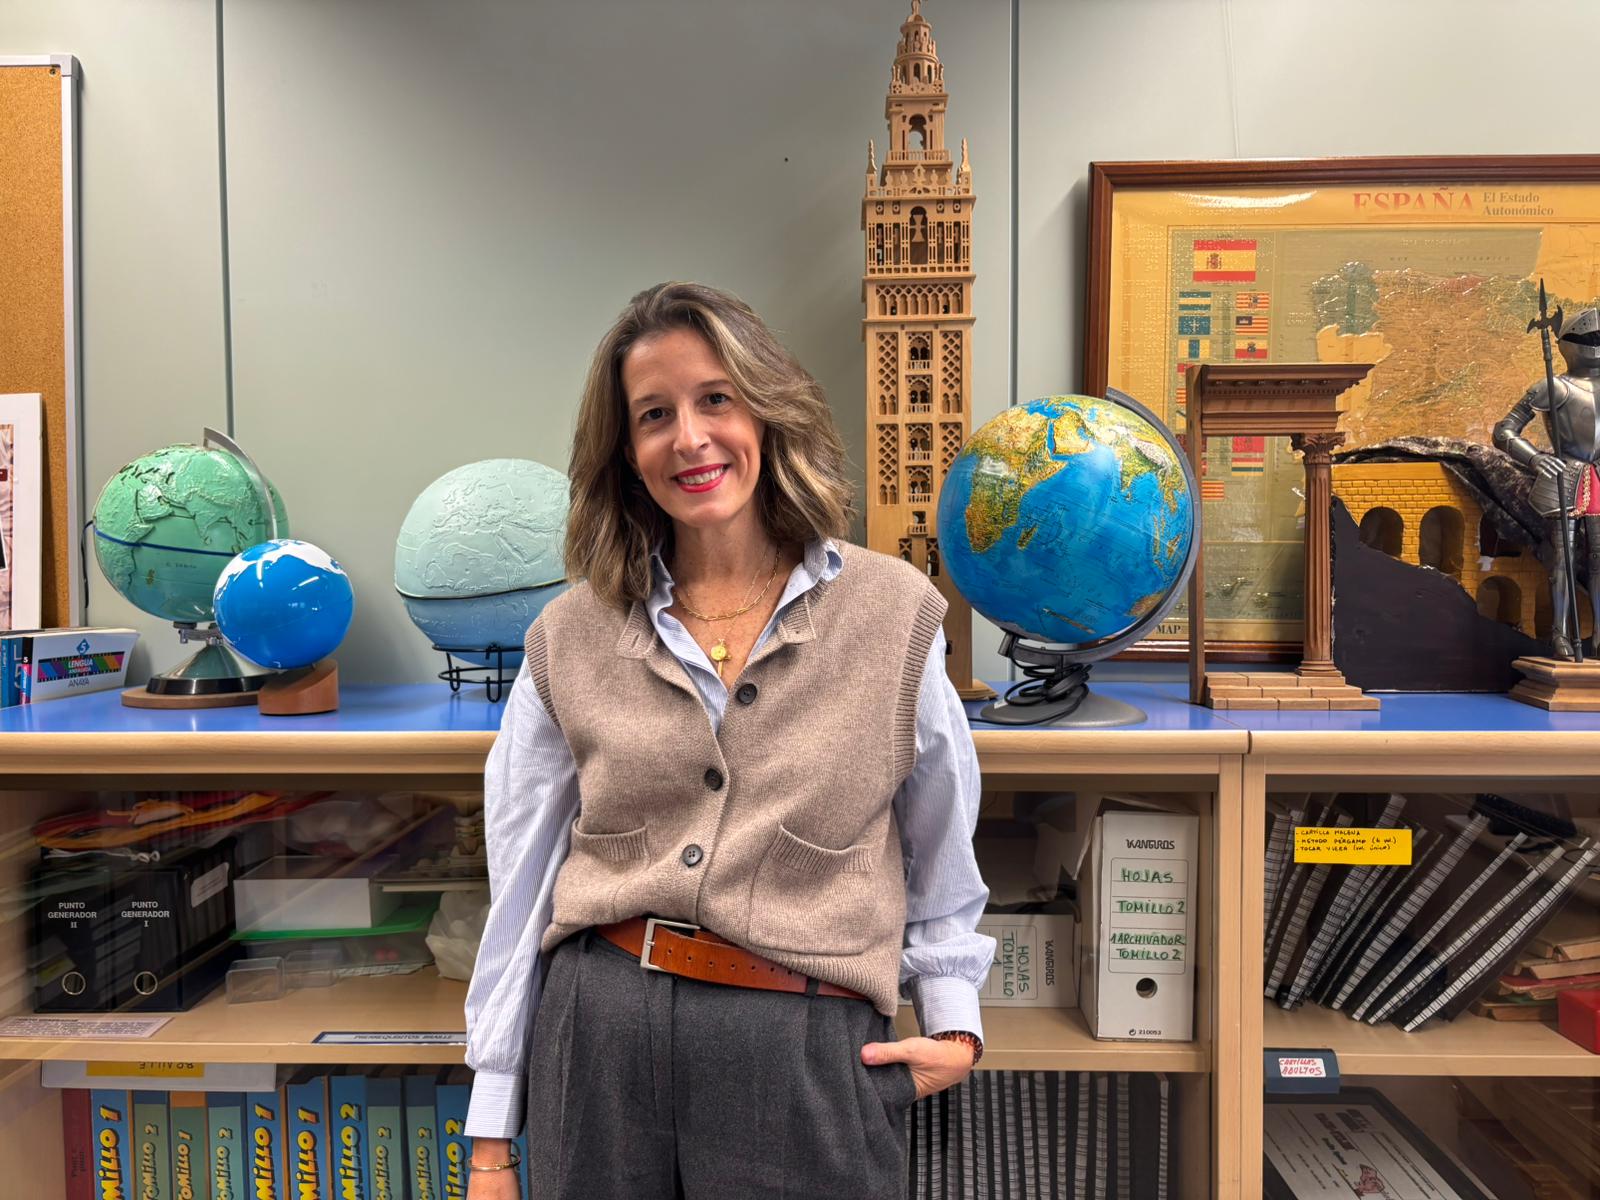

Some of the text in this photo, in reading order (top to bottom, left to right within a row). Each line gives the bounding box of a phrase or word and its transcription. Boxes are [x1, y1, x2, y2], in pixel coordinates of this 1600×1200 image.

[1353, 186, 1473, 210] ESPAÑA
[1483, 192, 1540, 203] El Estado
[1483, 205, 1554, 216] Autonómico
[67, 679, 90, 688] ANAYA
[1121, 868, 1174, 883] HOJAS
[131, 901, 159, 909] PUNTO
[1177, 901, 1185, 914] 2
[47, 911, 97, 919] GENERADOR
[121, 910, 170, 918] GENERADOR
[70, 921, 78, 929] II
[143, 920, 149, 928] I
[1117, 932, 1187, 945] ARCHIVADOR
[1172, 949, 1182, 960] 2
[1002, 931, 1015, 997] TOMILLO
[1017, 945, 1030, 993] HOJAS
[100, 1104, 122, 1121] 1
[254, 1104, 275, 1121] 1
[298, 1107, 320, 1124] 1
[340, 1103, 362, 1121] 2
[144, 1123, 159, 1136] 2
[218, 1127, 233, 1139] 2
[377, 1126, 391, 1139] 2
[417, 1127, 432, 1139] 2
[445, 1117, 465, 1136] 2
[178, 1130, 192, 1140] 1
